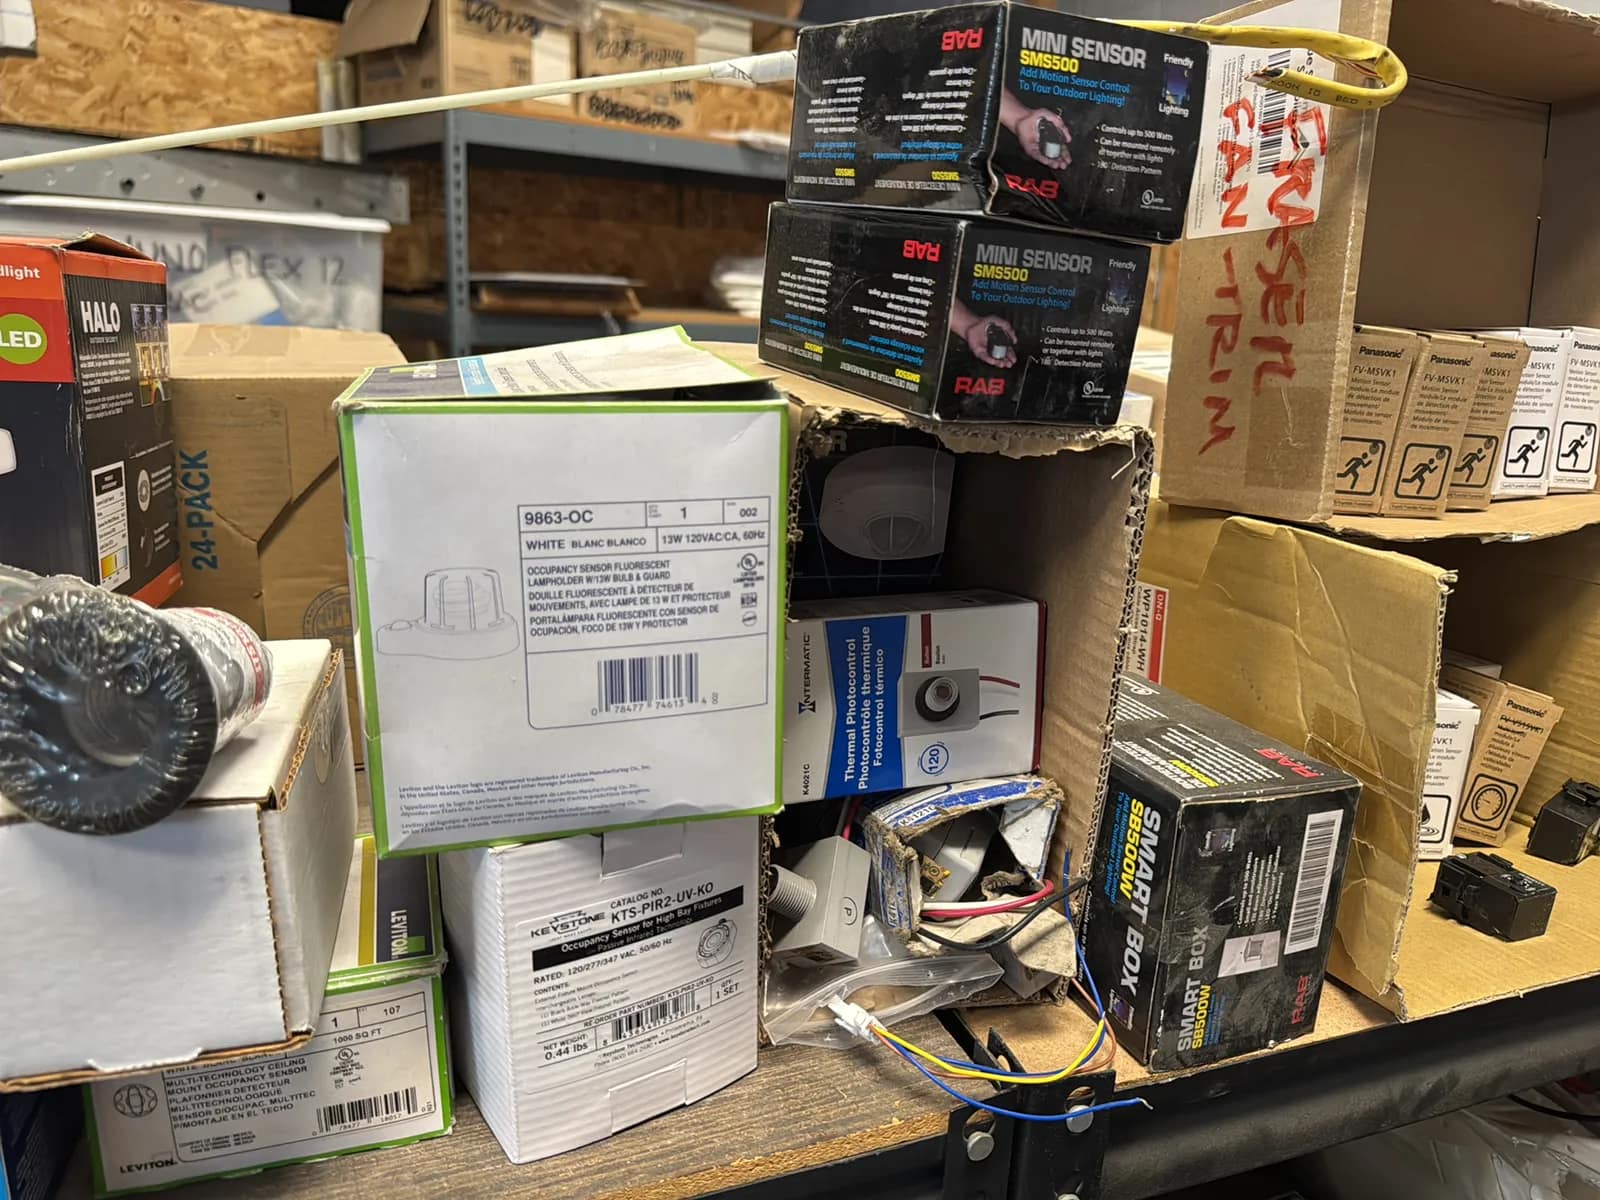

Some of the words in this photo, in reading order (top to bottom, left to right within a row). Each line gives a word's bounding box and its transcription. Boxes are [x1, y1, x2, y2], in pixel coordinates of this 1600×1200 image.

[942, 28, 983, 51] RAB
[1022, 27, 1066, 54] MINI
[1072, 37, 1146, 68] SENSOR
[1020, 50, 1080, 73] SMS500
[1164, 53, 1194, 68] Friendly
[1020, 68, 1037, 78] Add
[1040, 70, 1070, 83] Motion
[1071, 74, 1098, 87] Sensor
[1100, 79, 1131, 92] Control
[1019, 80, 1030, 90] To
[1032, 82, 1051, 94] Your
[1053, 86, 1088, 100] Outdoor
[1090, 91, 1126, 106] Lighting!
[1159, 103, 1189, 116] Lighting
[1102, 124, 1127, 136] Controls
[1156, 131, 1173, 140] Watts
[1121, 141, 1149, 152] mounted
[1112, 162, 1140, 173] Detection
[1141, 164, 1162, 176] Pattern
[1218, 98, 1256, 228] CAN
[1005, 174, 1060, 200] RAB
[903, 239, 940, 262] RAB
[976, 244, 1016, 266] MINI
[1022, 249, 1092, 274] SENSOR
[973, 264, 1028, 282] SMS500
[1109, 259, 1136, 272] Friendly
[972, 280, 990, 290] Add
[991, 282, 1018, 292] Motion
[1020, 284, 1046, 294] Sensor
[1047, 286, 1076, 297] Control
[972, 292, 982, 300] To
[984, 292, 1000, 302] Your
[1002, 294, 1034, 306] Outdoor
[1036, 298, 1072, 310] Lighting!
[1102, 304, 1130, 316] Lighting
[80, 300, 121, 333] HALO
[1046, 326, 1070, 335] Controls
[1358, 346, 1402, 358] Panasonic
[1430, 354, 1471, 366] Panasonic
[1353, 365, 1396, 378] FV-MSVK1
[1424, 374, 1465, 384] FV-MSVK1
[954, 376, 1006, 396] RAB
[180, 450, 218, 571] 24-PACK
[525, 510, 594, 525] 9863-OC
[680, 507, 687, 520] 1
[740, 508, 758, 518] 002
[526, 539, 566, 550] WHITE
[571, 538, 605, 549] BLANC
[606, 536, 647, 547] BLANCO
[662, 534, 682, 544] 13W
[743, 530, 766, 540] 60Hz
[528, 564, 578, 576] OCCUPANCY
[580, 562, 612, 574] SENSOR
[614, 560, 671, 572] FLUORESCENT
[528, 576, 584, 587] LAMPHOLDER
[612, 572, 634, 583] BULB
[644, 570, 671, 580] GUARD
[529, 589, 564, 600] DOUILLE
[566, 586, 630, 598] FLUORESCENTE
[684, 582, 694, 592] DE
[529, 600, 588, 612] MOUVEMENTS,
[589, 598, 610, 609] AVEC
[610, 597, 636, 608] LAMPE
[638, 596, 651, 606] DE
[682, 590, 731, 602] PROTECTEUR
[596, 609, 658, 622] FLUORESCENTE
[659, 608, 676, 618] CON
[677, 606, 708, 616] SENSOR
[709, 604, 720, 614] DE
[582, 623, 606, 633] FOCO
[606, 622, 618, 632] DE
[618, 620, 635, 631] 13W
[642, 617, 688, 628] PROTECTOR
[1137, 588, 1152, 672] WP1014-WH
[860, 626, 871, 698] thermique
[874, 648, 884, 695] térmico
[798, 632, 816, 715] INTERMATIC
[846, 638, 856, 724] Photocontrol
[614, 704, 645, 714] 78477
[655, 700, 684, 710] 74613
[1506, 699, 1546, 718] Panasonic
[873, 698, 883, 766] Fotocontrol
[844, 727, 856, 782] Thermal
[858, 699, 871, 790] Photocontrôle
[928, 748, 940, 772] 120
[1256, 748, 1319, 779] RAB
[802, 763, 810, 796] K4021C
[1120, 798, 1144, 900] SB500W
[1130, 806, 1162, 924] SMART
[610, 892, 649, 909] CATALOG
[651, 888, 664, 898] NO.
[611, 882, 714, 924] KTS-PIR2-UV-KO
[390, 910, 408, 960] LEVITON
[531, 912, 606, 938] KEYSTONE
[561, 932, 610, 952] Occupancy
[612, 924, 640, 938] Sensor
[642, 920, 654, 928] for
[656, 912, 675, 924] High
[677, 907, 692, 918] Bay
[694, 897, 722, 912] Fixtures
[534, 971, 563, 984] RATED:
[568, 954, 618, 976] 120/277/347
[662, 938, 673, 946] Hz
[1120, 930, 1146, 997] BOX
[716, 991, 720, 1000] 1
[723, 982, 740, 996] SET
[1178, 978, 1200, 1051] SMART
[1189, 925, 1208, 970] BOX
[384, 1005, 401, 1016] 107
[619, 1006, 636, 1016] PART
[1291, 976, 1308, 1024] RAB
[331, 1017, 338, 1028] 1
[1192, 984, 1211, 1050] SB500W
[334, 1035, 354, 1044] 1000
[355, 1031, 369, 1040] SQ
[371, 1028, 383, 1036] FT
[544, 1042, 558, 1051] NET
[544, 1048, 570, 1061] 0.44
[573, 1044, 588, 1052] lbs
[166, 1064, 265, 1088] MULTI-TECHNOLOGY
[268, 1058, 306, 1070] CEILING
[168, 1084, 202, 1096] MOUNT
[205, 1074, 266, 1090] OCCUPANCY
[268, 1066, 308, 1078] SENSOR
[169, 1090, 232, 1104] PLAFONNIER
[170, 1089, 282, 1113] MULTITECHNOLOGIQUE
[172, 1110, 212, 1122] SENSOR
[270, 1090, 316, 1105] MULTITEC
[173, 1116, 230, 1130] P/MONTAJE
[231, 1112, 244, 1121] EN
[246, 1110, 258, 1118] EL
[261, 1103, 294, 1116] TECHO
[120, 1157, 175, 1174] LEVITON
